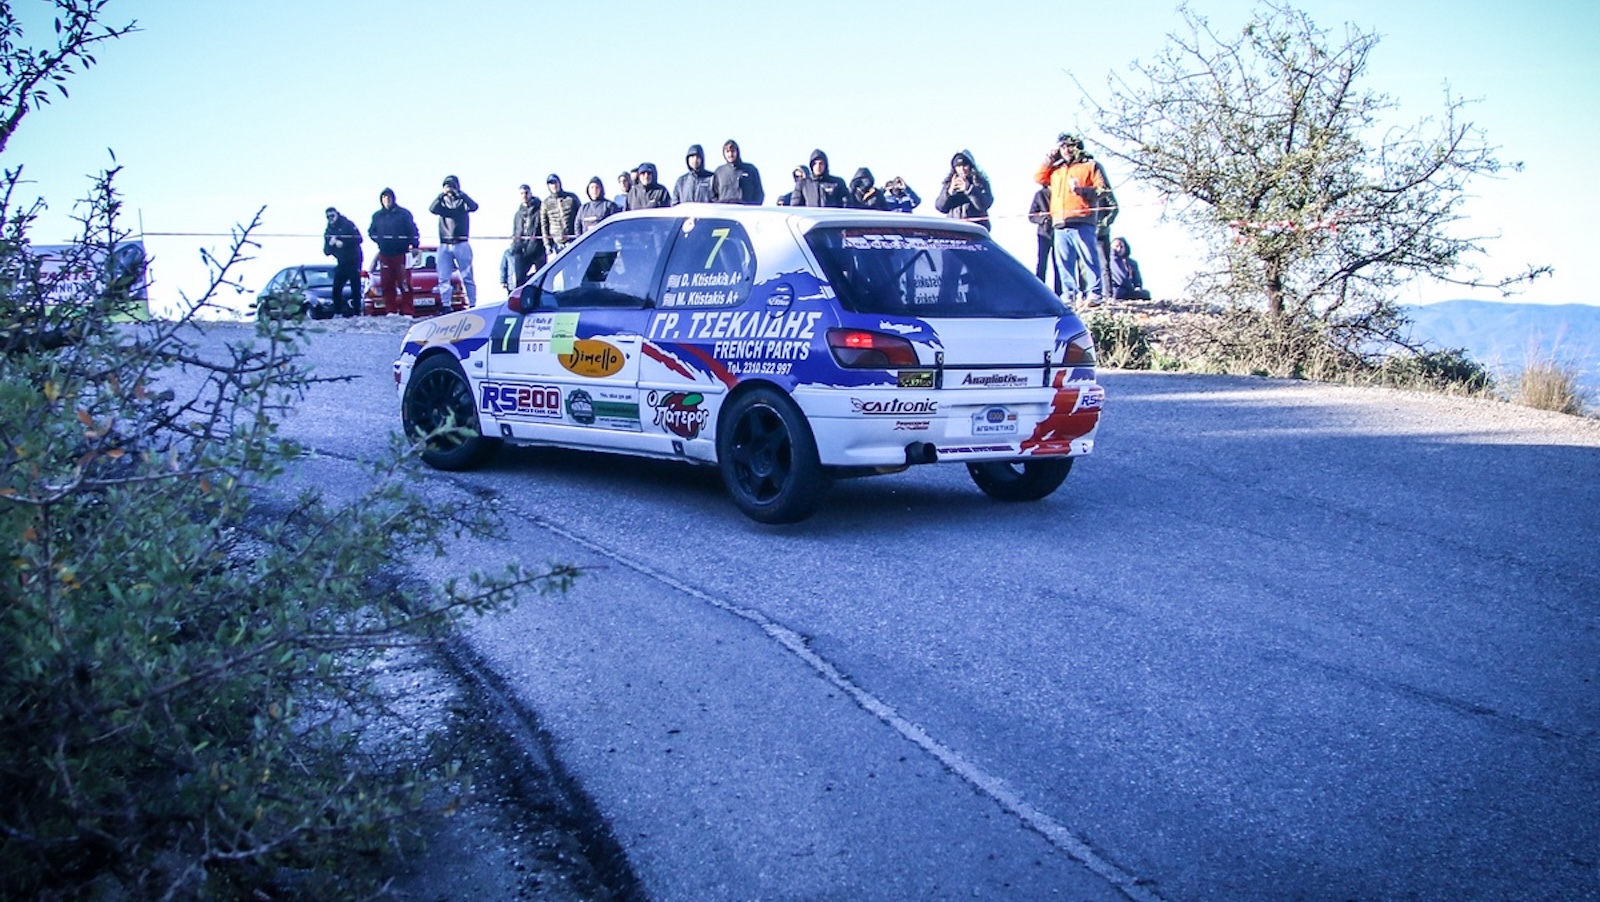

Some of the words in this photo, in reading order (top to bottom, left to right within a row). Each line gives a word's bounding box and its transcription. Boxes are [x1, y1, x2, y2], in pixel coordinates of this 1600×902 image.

[704, 228, 731, 269] 7
[681, 273, 690, 287] D.
[691, 272, 729, 287] Ktistakis
[729, 271, 742, 286] A+
[676, 292, 687, 306] M.
[687, 291, 725, 306] Ktistakis
[725, 290, 739, 305] A+
[425, 317, 472, 341] Dimello
[502, 317, 518, 351] 7
[649, 312, 680, 339] ΓΡ.
[688, 311, 823, 339] ΤΣΕΚΛΙΔΗΣ
[569, 347, 617, 371] Dimello
[713, 341, 764, 360] FRENCH
[765, 341, 811, 360] PARTS
[743, 362, 760, 374] 2310
[761, 363, 775, 375] 522
[776, 363, 792, 375] 997
[482, 386, 559, 412] RS200
